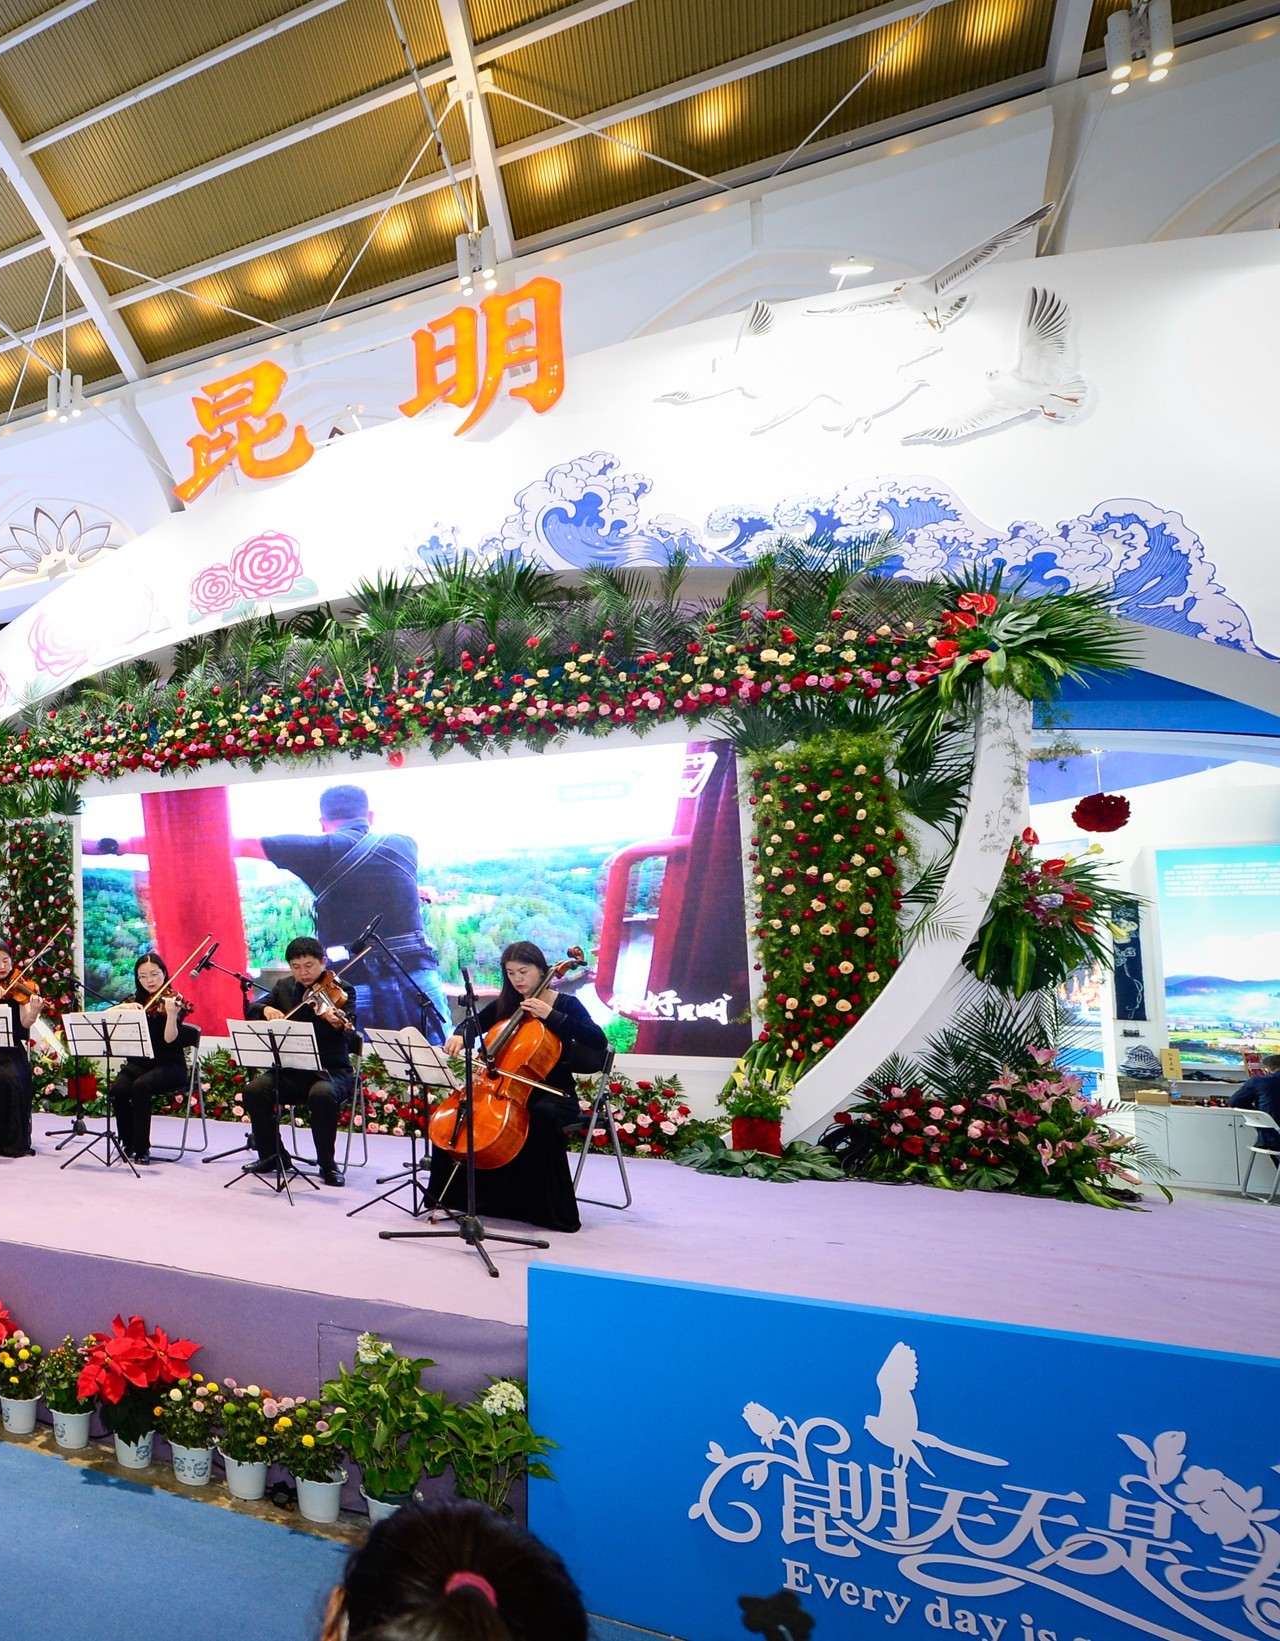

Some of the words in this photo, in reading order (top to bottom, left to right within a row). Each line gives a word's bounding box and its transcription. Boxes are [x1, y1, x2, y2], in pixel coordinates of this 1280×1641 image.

[173, 276, 566, 503] 昆明
[781, 1557, 911, 1625] Every
[924, 1596, 1007, 1641] day
